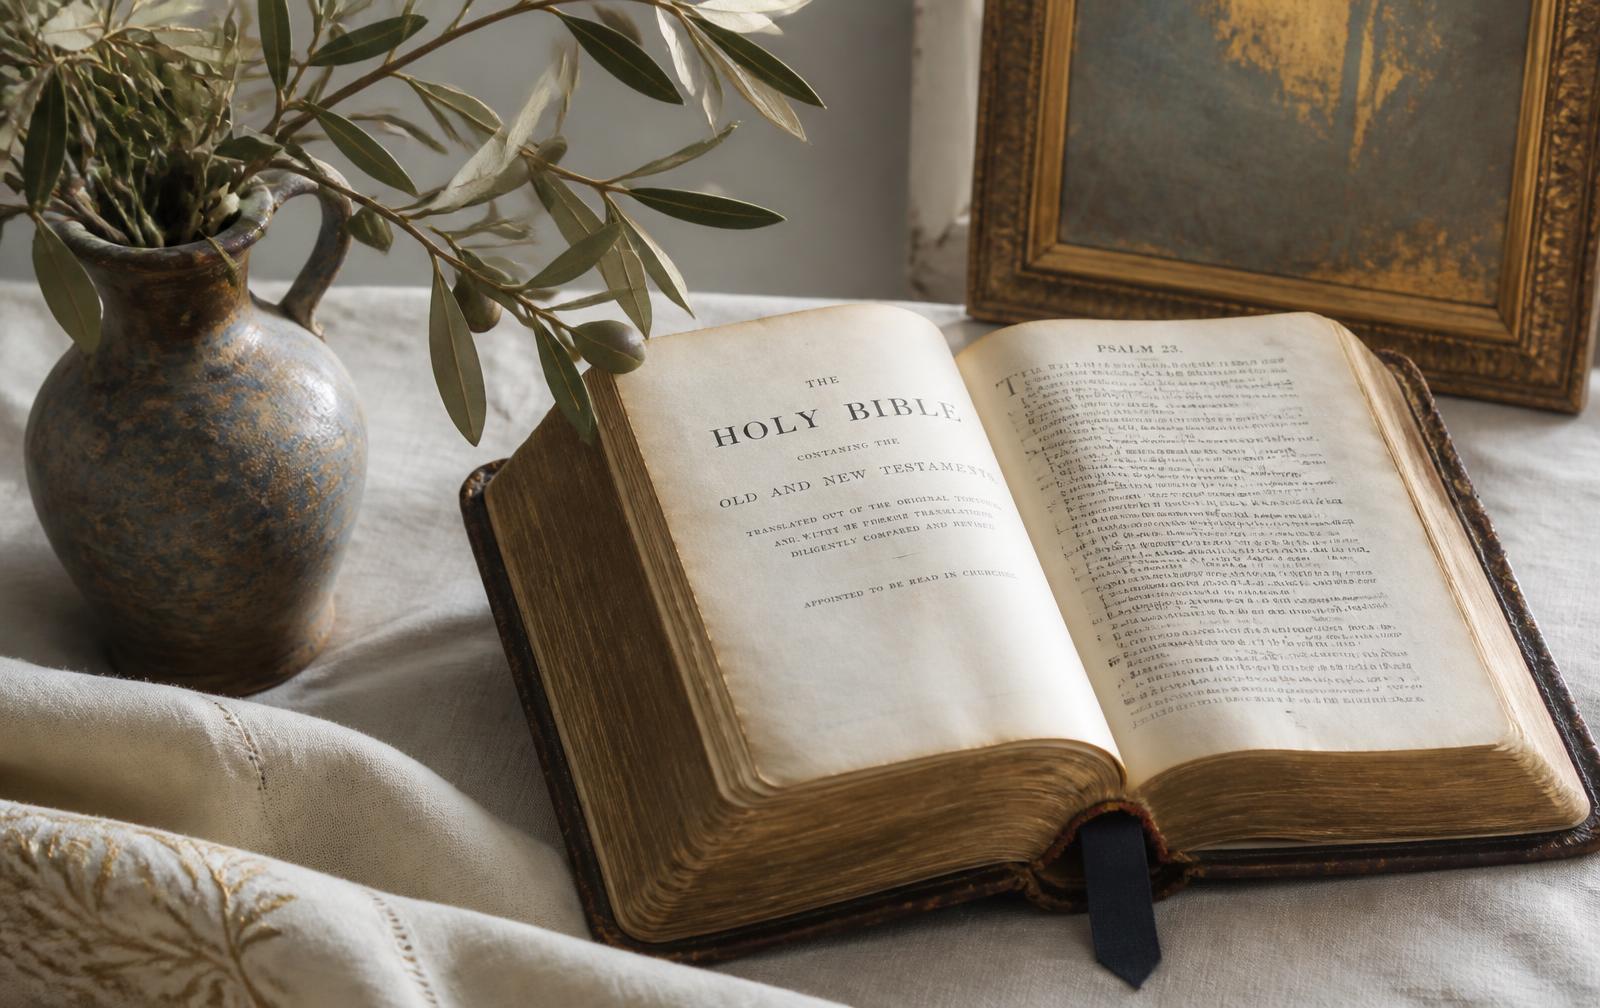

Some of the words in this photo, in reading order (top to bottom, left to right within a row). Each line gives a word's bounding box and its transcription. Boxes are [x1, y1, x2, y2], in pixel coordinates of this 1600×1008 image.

[1096, 344, 1154, 354] PSALM
[805, 376, 839, 388] THE
[710, 408, 819, 448] HOLY
[843, 397, 962, 422] BIBLE
[797, 442, 869, 462] CONTANING
[874, 438, 900, 447] THE
[719, 492, 758, 509] OLD
[771, 480, 811, 498] AND
[822, 469, 866, 487] NEW
[745, 516, 818, 537] TRANSLATED
[822, 511, 844, 520] OUT
[868, 501, 892, 511] THE
[791, 537, 857, 558] DILIGENTLY
[863, 525, 920, 542] COMPARED
[926, 522, 947, 530] AND
[869, 586, 884, 594] TO
[889, 581, 904, 590] BE
[909, 574, 938, 585] READ
